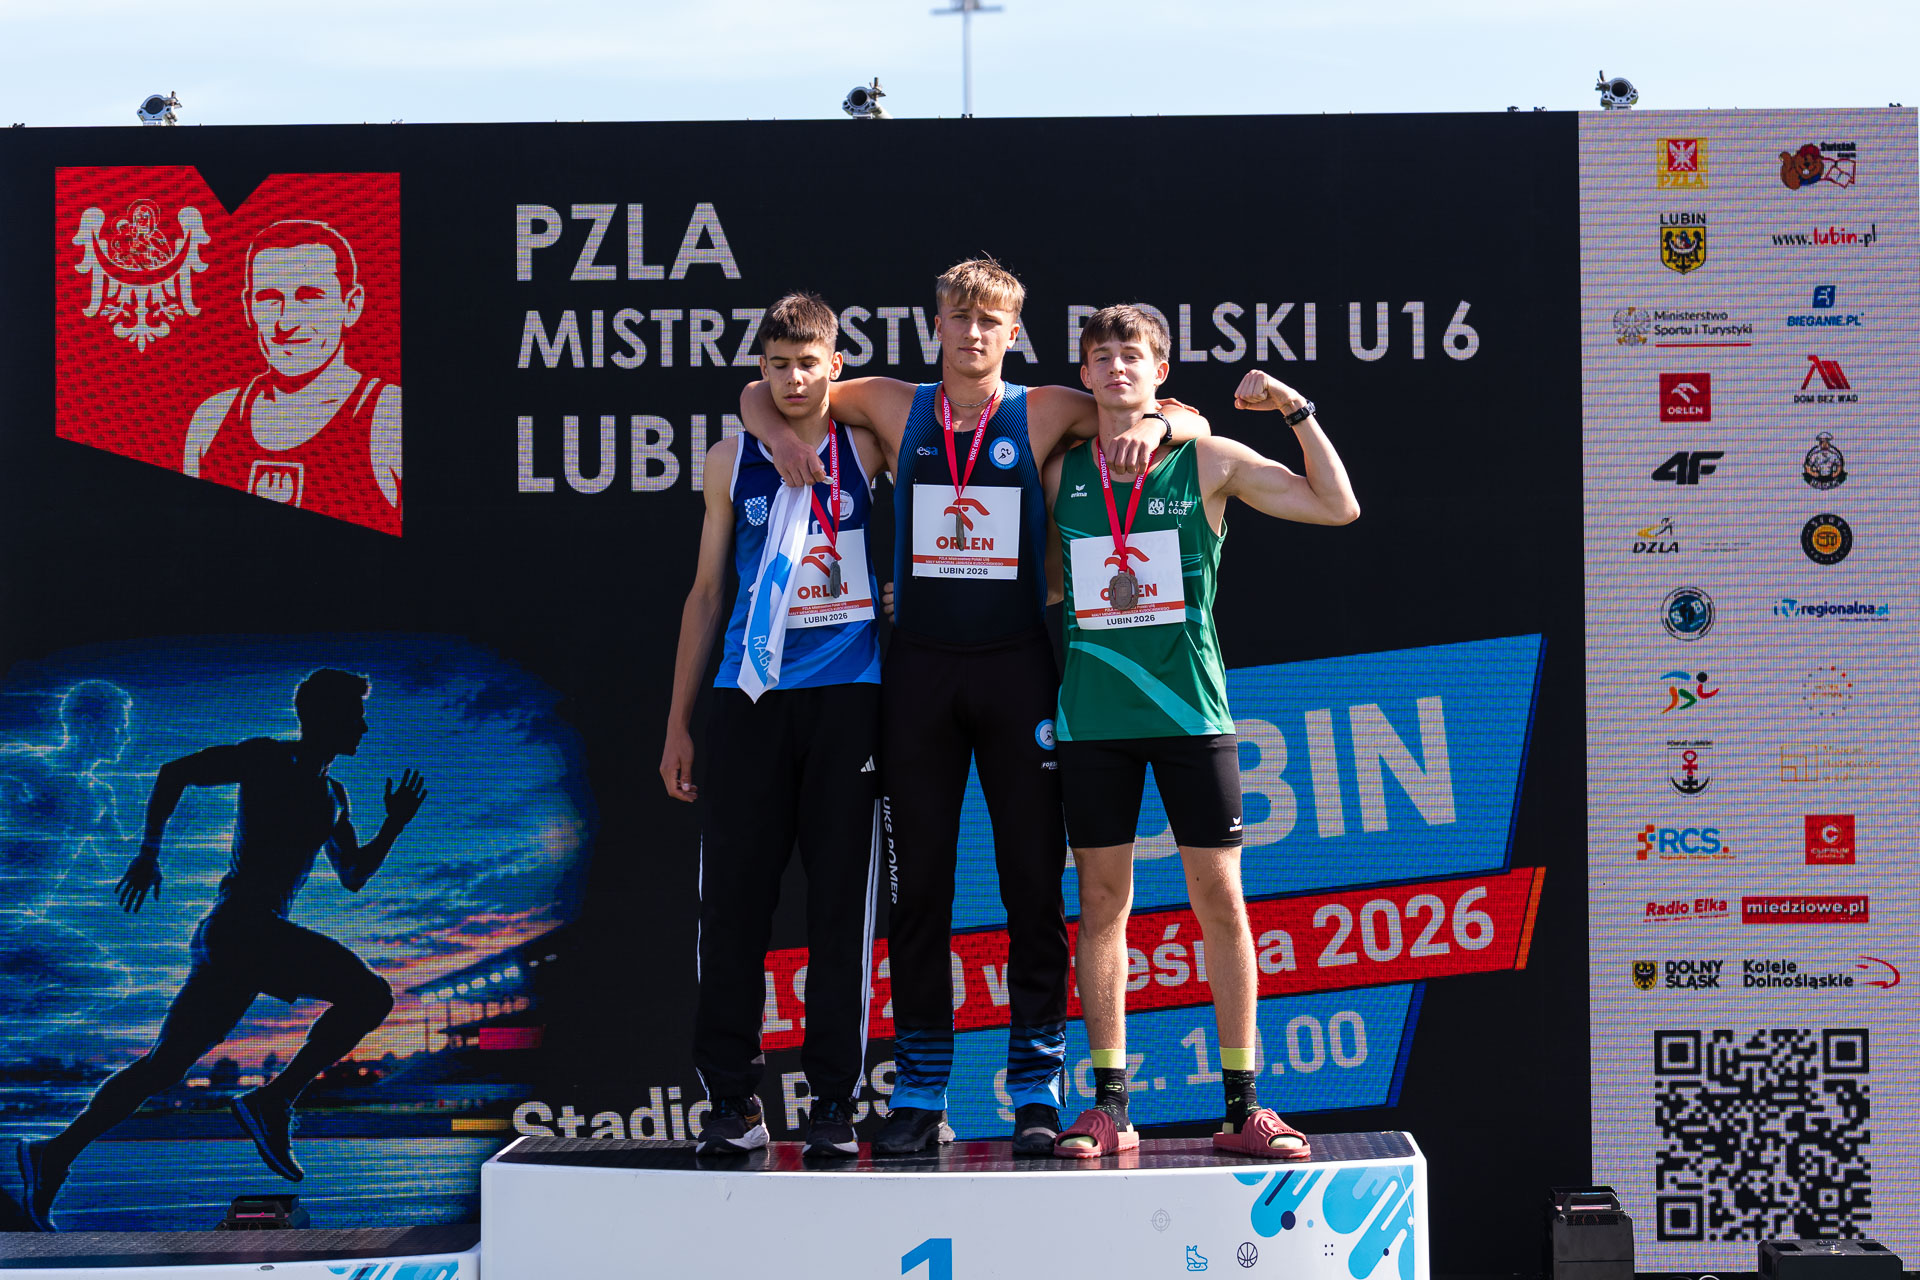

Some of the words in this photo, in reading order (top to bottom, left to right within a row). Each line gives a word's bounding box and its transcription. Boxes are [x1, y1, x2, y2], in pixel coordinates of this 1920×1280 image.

[1660, 213, 1706, 225] LUBIN
[516, 202, 741, 281] PZLA
[1772, 224, 1876, 247] www.lubin.pl
[1654, 311, 1728, 320] Ministerstwo
[1787, 315, 1861, 326] BIEGANIE.PL
[1067, 302, 1318, 364] PLSKI
[1348, 300, 1480, 362] U16
[1654, 325, 1692, 336] Sportu
[1702, 324, 1752, 336] Turystyki
[1794, 395, 1814, 403] DOM
[1838, 395, 1858, 403] WAD
[1667, 407, 1703, 415] ORLEN
[973, 428, 983, 448] POLSKI
[517, 414, 746, 495] LUBI
[968, 447, 978, 461] 2026
[1652, 451, 1724, 485] 4F
[1633, 542, 1679, 553] DZLA
[939, 567, 965, 575] LUBIN
[966, 567, 988, 575] 2026
[797, 581, 849, 600] ORLN
[1100, 583, 1158, 601] OEN
[804, 615, 828, 624] LUBIN
[829, 612, 848, 621] 2026
[1106, 617, 1132, 625] LUBIN
[1134, 614, 1156, 623] 2026
[1133, 695, 1457, 860] BIN
[883, 796, 893, 833] UKS
[1645, 901, 1690, 917] Radio
[1694, 898, 1728, 913] Elka
[1747, 901, 1865, 915] miedziowe.pl
[1312, 885, 1495, 968] 2026
[1665, 960, 1723, 974] DOLNY
[1743, 959, 1797, 975] Koleje
[1665, 974, 1720, 990] ŚLĄSK
[1743, 974, 1854, 989] Dolnośląskie
[1181, 1011, 1369, 1086] 1.00
